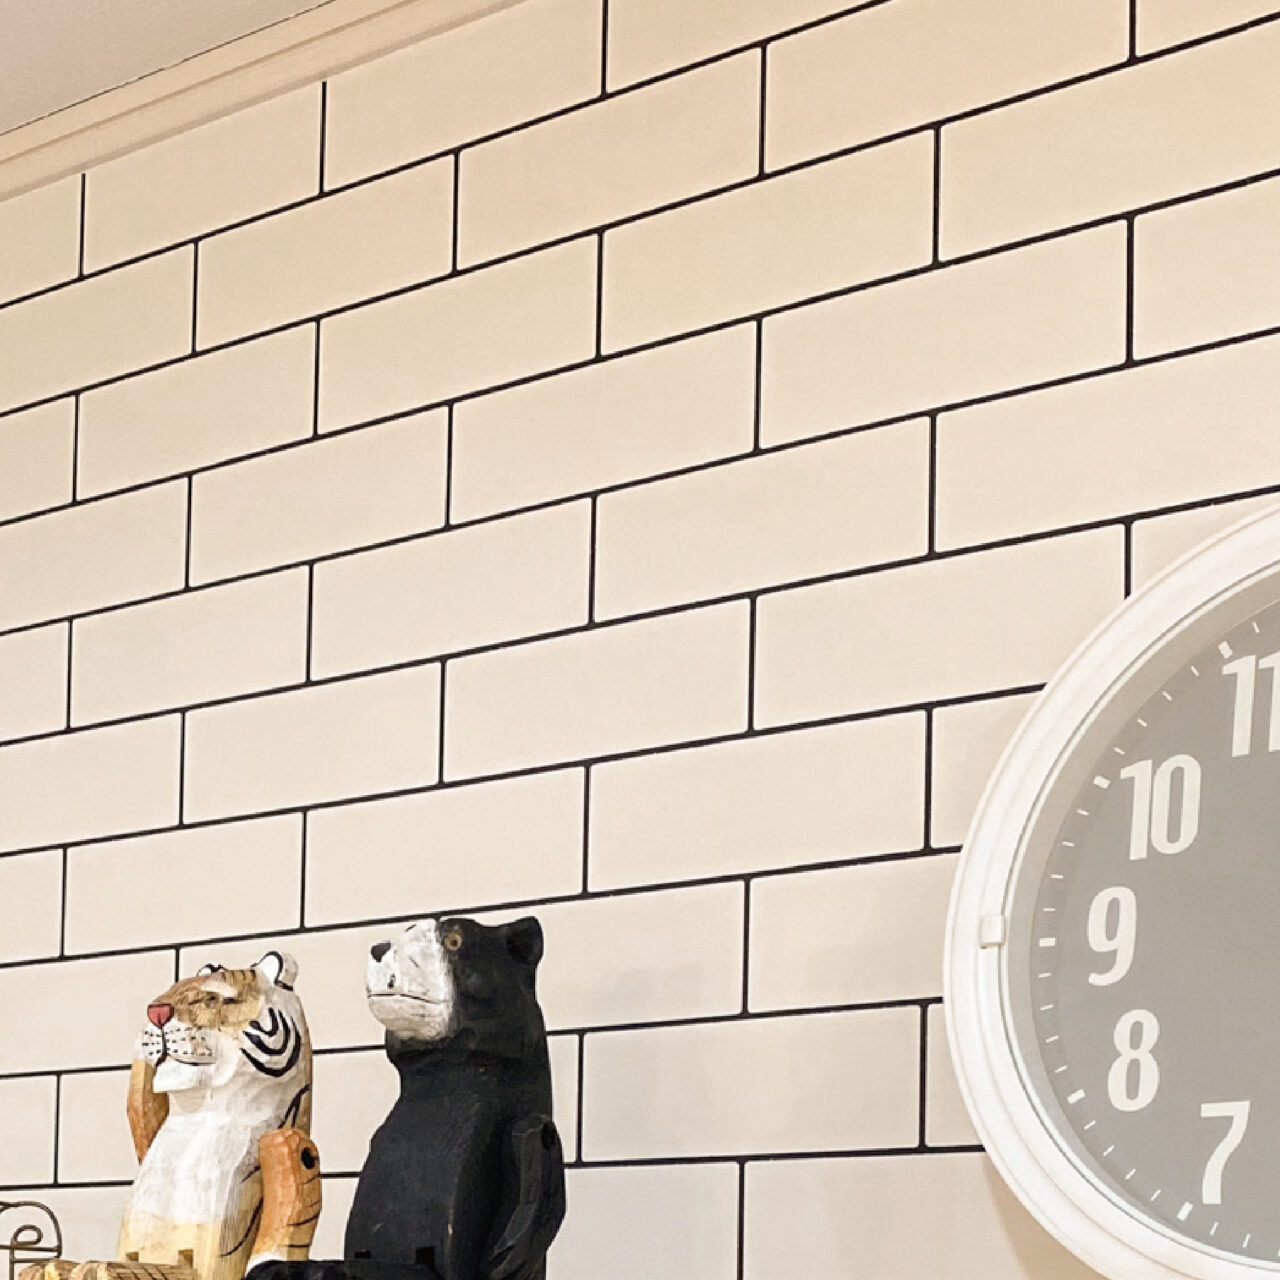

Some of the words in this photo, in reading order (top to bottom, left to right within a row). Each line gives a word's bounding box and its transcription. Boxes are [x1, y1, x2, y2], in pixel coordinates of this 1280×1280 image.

[1120, 754, 1202, 861] 10
[1087, 886, 1137, 986] 9
[1107, 1009, 1160, 1112] 8
[1200, 1100, 1251, 1205] 7
